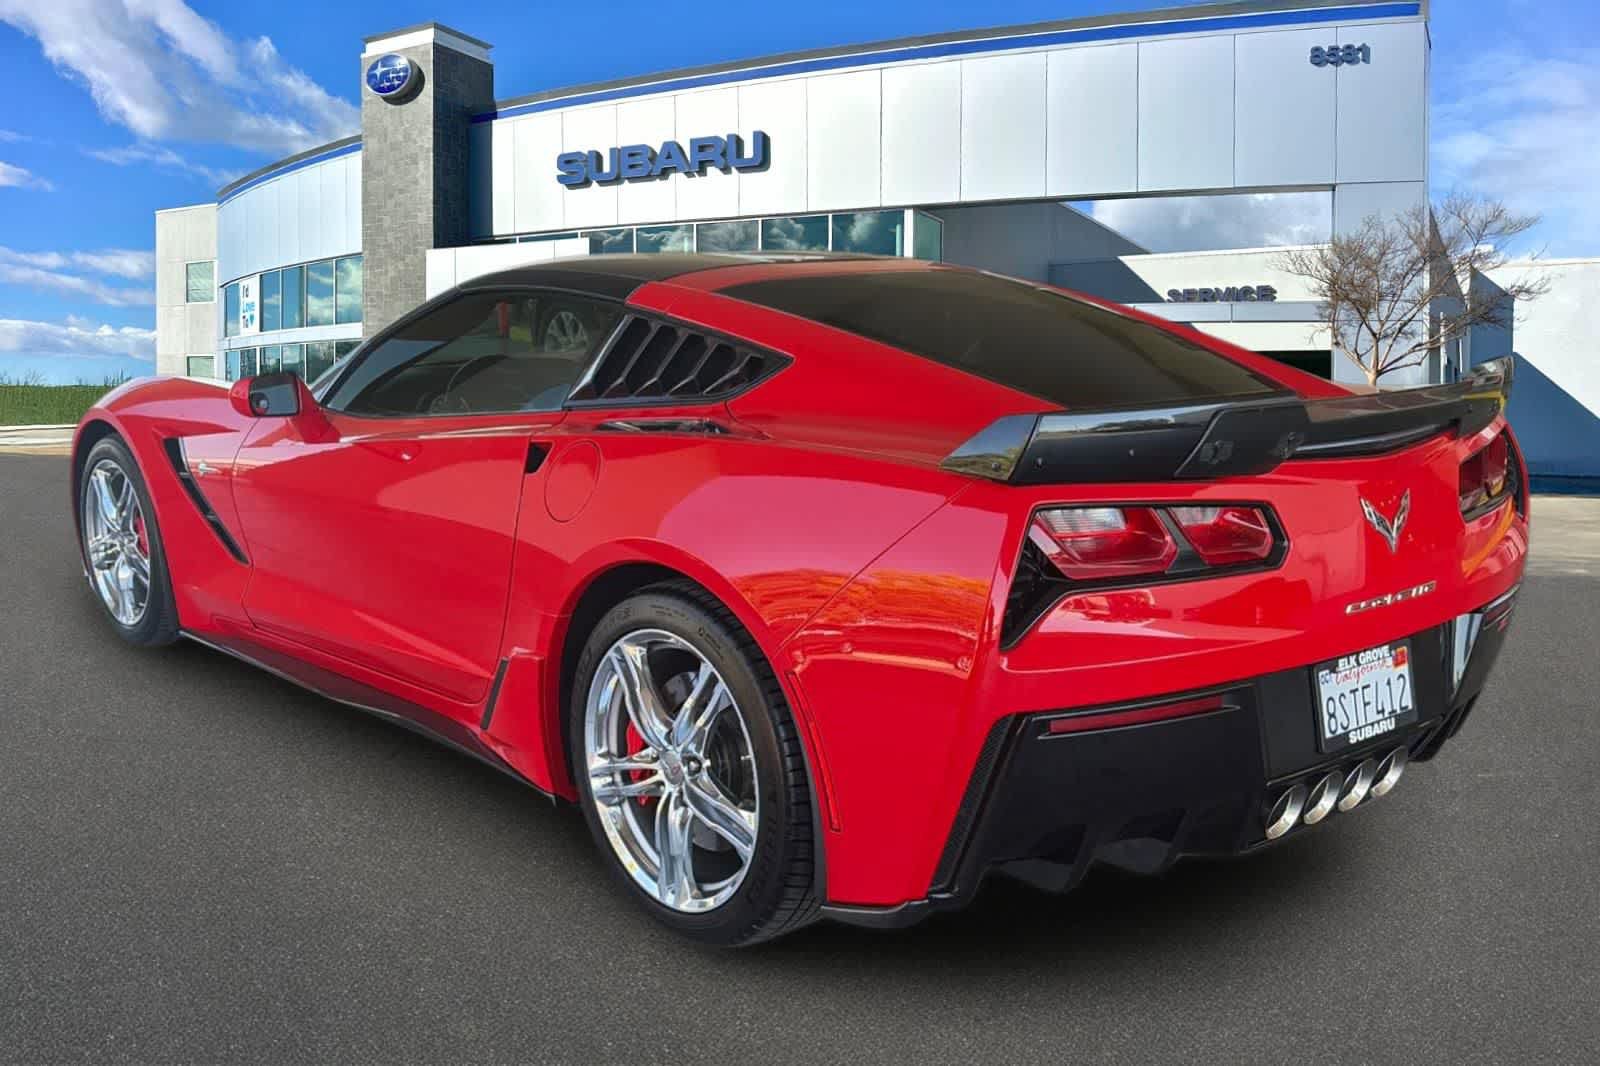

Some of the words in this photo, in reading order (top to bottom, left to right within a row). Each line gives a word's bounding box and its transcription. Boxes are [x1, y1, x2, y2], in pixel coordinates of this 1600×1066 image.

[557, 130, 771, 190] SUBARU
[1167, 285, 1277, 303] SERVICE
[1338, 653, 1358, 669] ELK
[1359, 645, 1390, 665] GROVE
[1326, 673, 1409, 735] 8STF412
[1348, 717, 1395, 744] SUBARU
